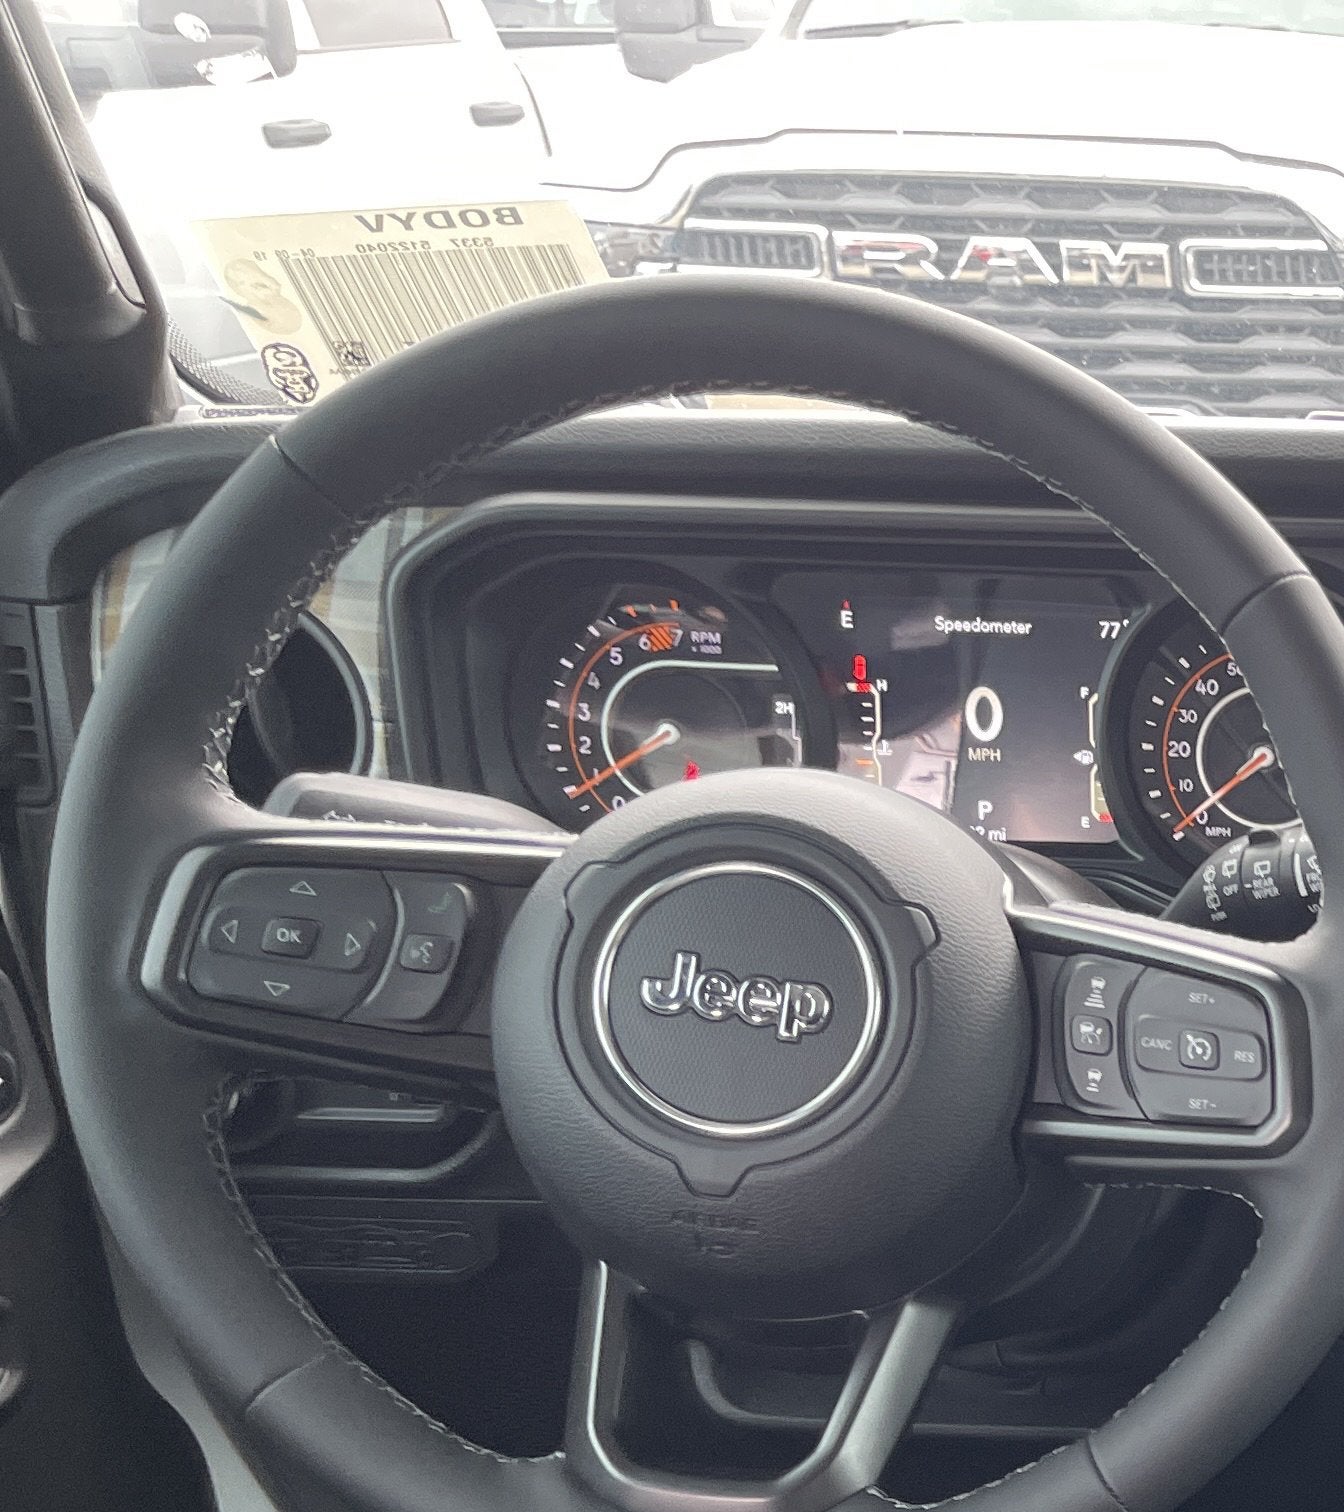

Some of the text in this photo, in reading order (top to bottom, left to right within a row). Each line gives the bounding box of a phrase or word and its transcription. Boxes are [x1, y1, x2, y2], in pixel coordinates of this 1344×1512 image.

[834, 230, 1174, 290] RAM
[840, 610, 853, 629] E
[934, 615, 1033, 637] Speedometer
[638, 634, 650, 651] 6
[691, 631, 722, 644] RPM
[609, 647, 623, 666] 5
[587, 672, 601, 690] 4
[1195, 677, 1220, 696] 40
[1080, 686, 1090, 700] F
[578, 703, 592, 722] 3
[965, 685, 1004, 742] 0
[1178, 708, 1199, 725] 30
[578, 736, 592, 755] 2
[968, 746, 1001, 762] MPH
[1168, 740, 1192, 759] 20
[1178, 778, 1195, 794] 10
[977, 800, 993, 822] P
[1081, 816, 1090, 828] E
[988, 826, 1007, 842] mi
[1205, 826, 1232, 838] MPH
[276, 927, 302, 945] OK
[639, 950, 834, 1043] Jeep
[1140, 1036, 1173, 1051] CANC
[1233, 1050, 1256, 1063] RES
